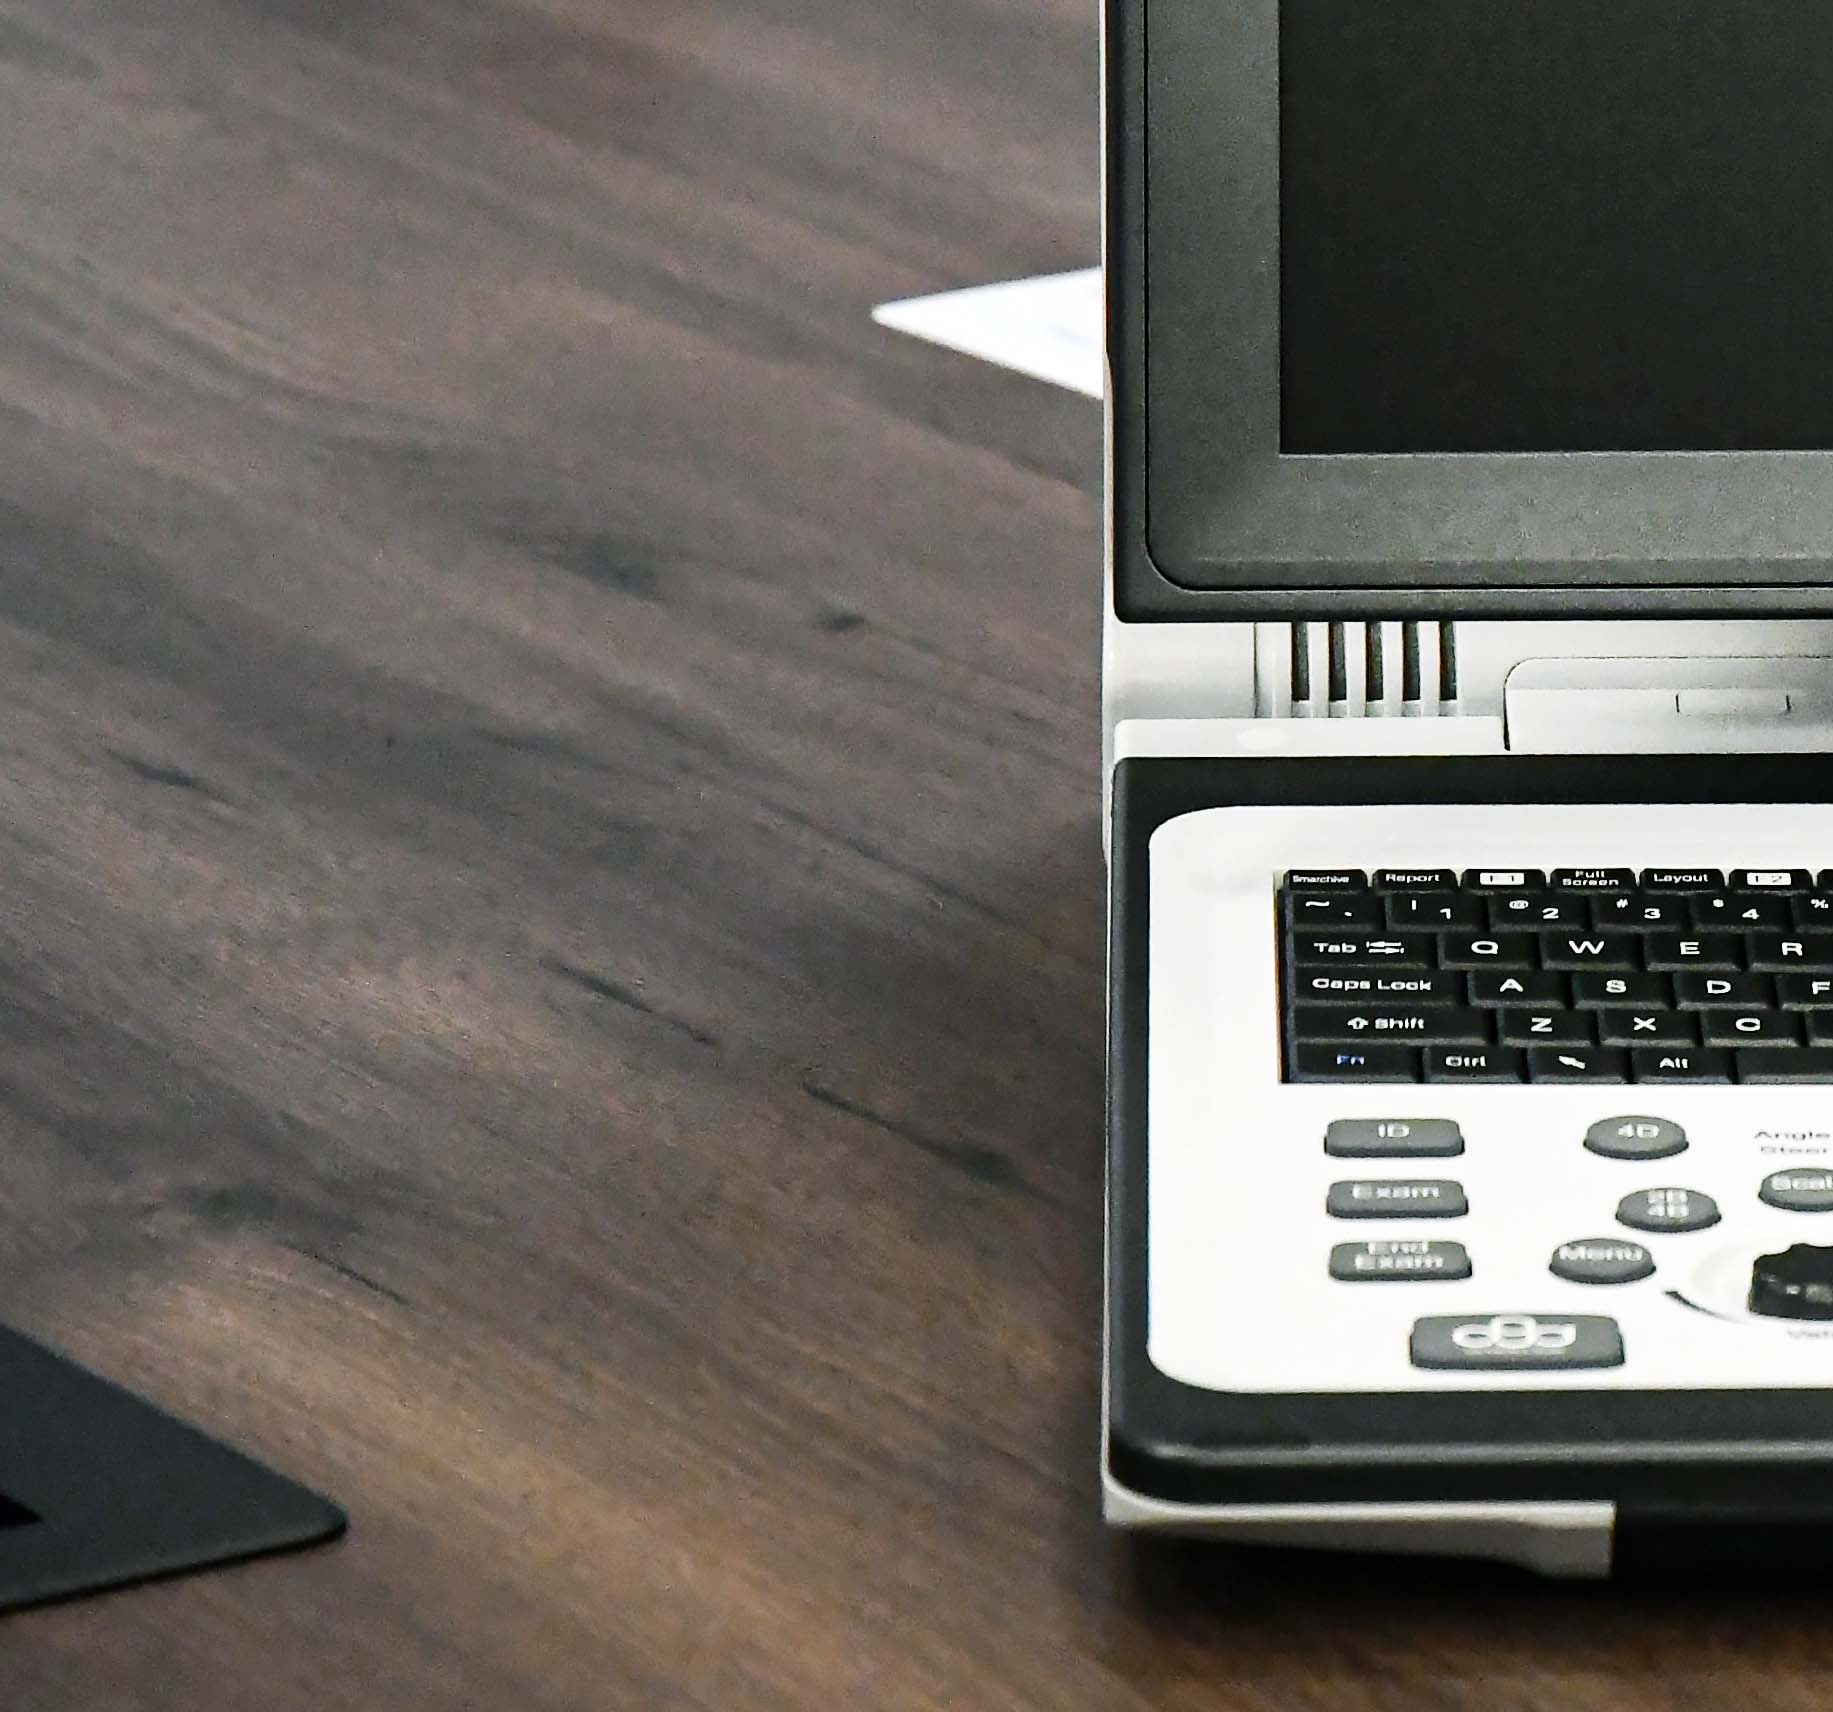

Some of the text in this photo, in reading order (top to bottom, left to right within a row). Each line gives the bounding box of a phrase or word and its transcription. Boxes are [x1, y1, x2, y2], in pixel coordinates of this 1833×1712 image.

[1386, 874, 1439, 883] Report
[1654, 874, 1708, 883] Layout
[1440, 909, 1451, 919] 1
[1543, 908, 1559, 919] 2
[1644, 908, 1660, 919] 3
[1742, 909, 1759, 919] 4
[1314, 943, 1356, 953] Tab
[1471, 941, 1498, 954] Q
[1569, 941, 1604, 954] W
[1680, 942, 1700, 954] E
[1782, 942, 1802, 955] R
[1312, 979, 1431, 991] Caps Lock
[1500, 979, 1523, 992] A
[1606, 980, 1626, 992] S
[1707, 980, 1731, 994] D
[1812, 982, 1830, 994] F
[1375, 1018, 1424, 1029] Shift
[1531, 1018, 1552, 1032] Z
[1634, 1017, 1656, 1030] X
[1736, 1018, 1760, 1031] C
[1337, 1055, 1364, 1064] Fn
[1446, 1056, 1485, 1066] Ctrl
[1660, 1058, 1687, 1068] Alt
[1378, 1123, 1410, 1138] ID
[1754, 1131, 1830, 1141] Angle
[1558, 1245, 1642, 1262] Menu
